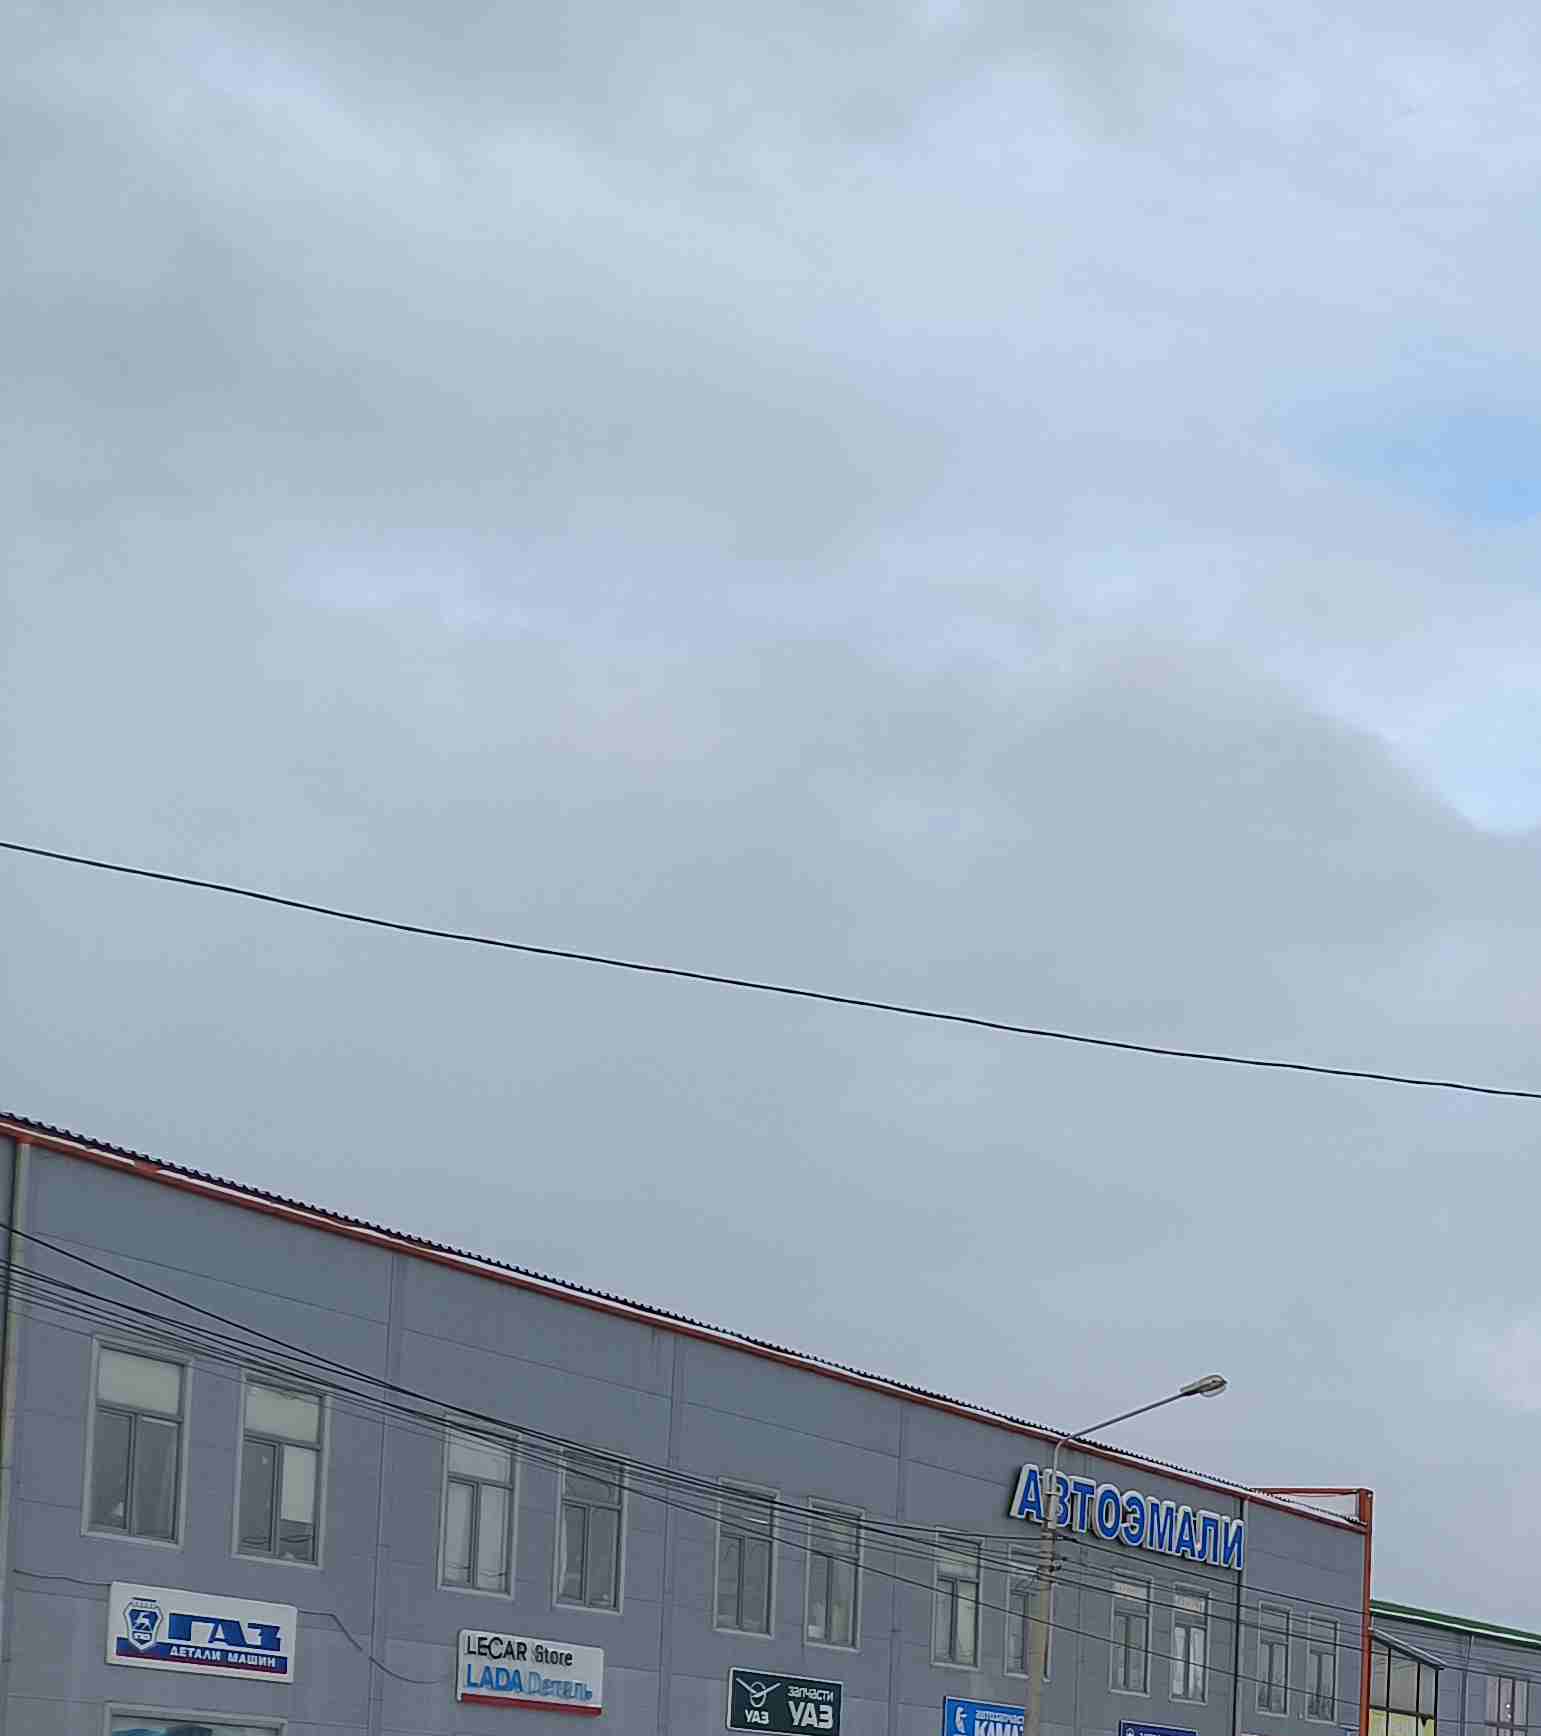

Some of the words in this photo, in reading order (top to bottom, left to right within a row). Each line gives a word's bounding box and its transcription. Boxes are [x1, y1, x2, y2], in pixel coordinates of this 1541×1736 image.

[1010, 1464, 1245, 1570] АВТОЭМАЛИ
[168, 1612, 281, 1652] ГАЗ
[169, 1645, 222, 1661] ДЕТАЛИ
[228, 1652, 277, 1668] МАШИН
[466, 1635, 527, 1662] LECAR
[534, 1644, 573, 1667] Store
[466, 1663, 523, 1692] LADA
[745, 1709, 769, 1725] УАЗ
[788, 1701, 833, 1729] УАЗ
